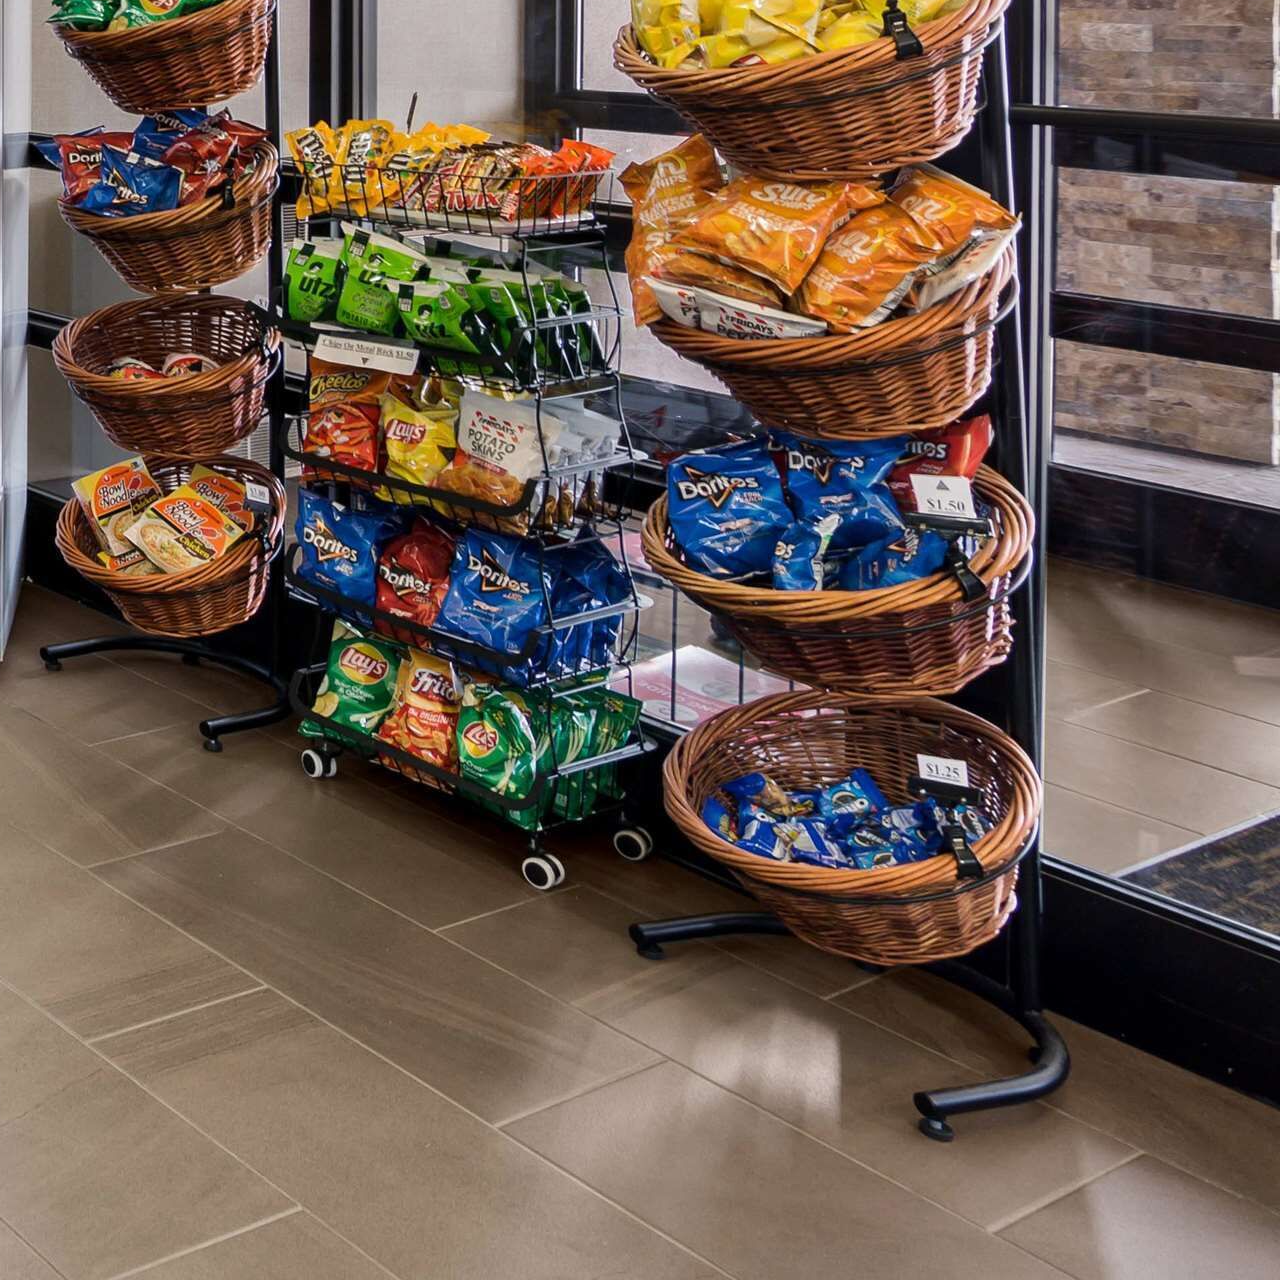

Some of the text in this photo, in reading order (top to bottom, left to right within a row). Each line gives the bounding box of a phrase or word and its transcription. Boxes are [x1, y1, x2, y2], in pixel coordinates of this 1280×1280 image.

[468, 428, 515, 454] POTATO
[471, 440, 506, 461] SKINS
[100, 479, 127, 497] Bowl
[926, 498, 966, 512] $1.50
[304, 526, 358, 562] Doritos
[468, 556, 530, 595] Doritos
[411, 668, 454, 700] Frito
[926, 762, 960, 778] $1.25
